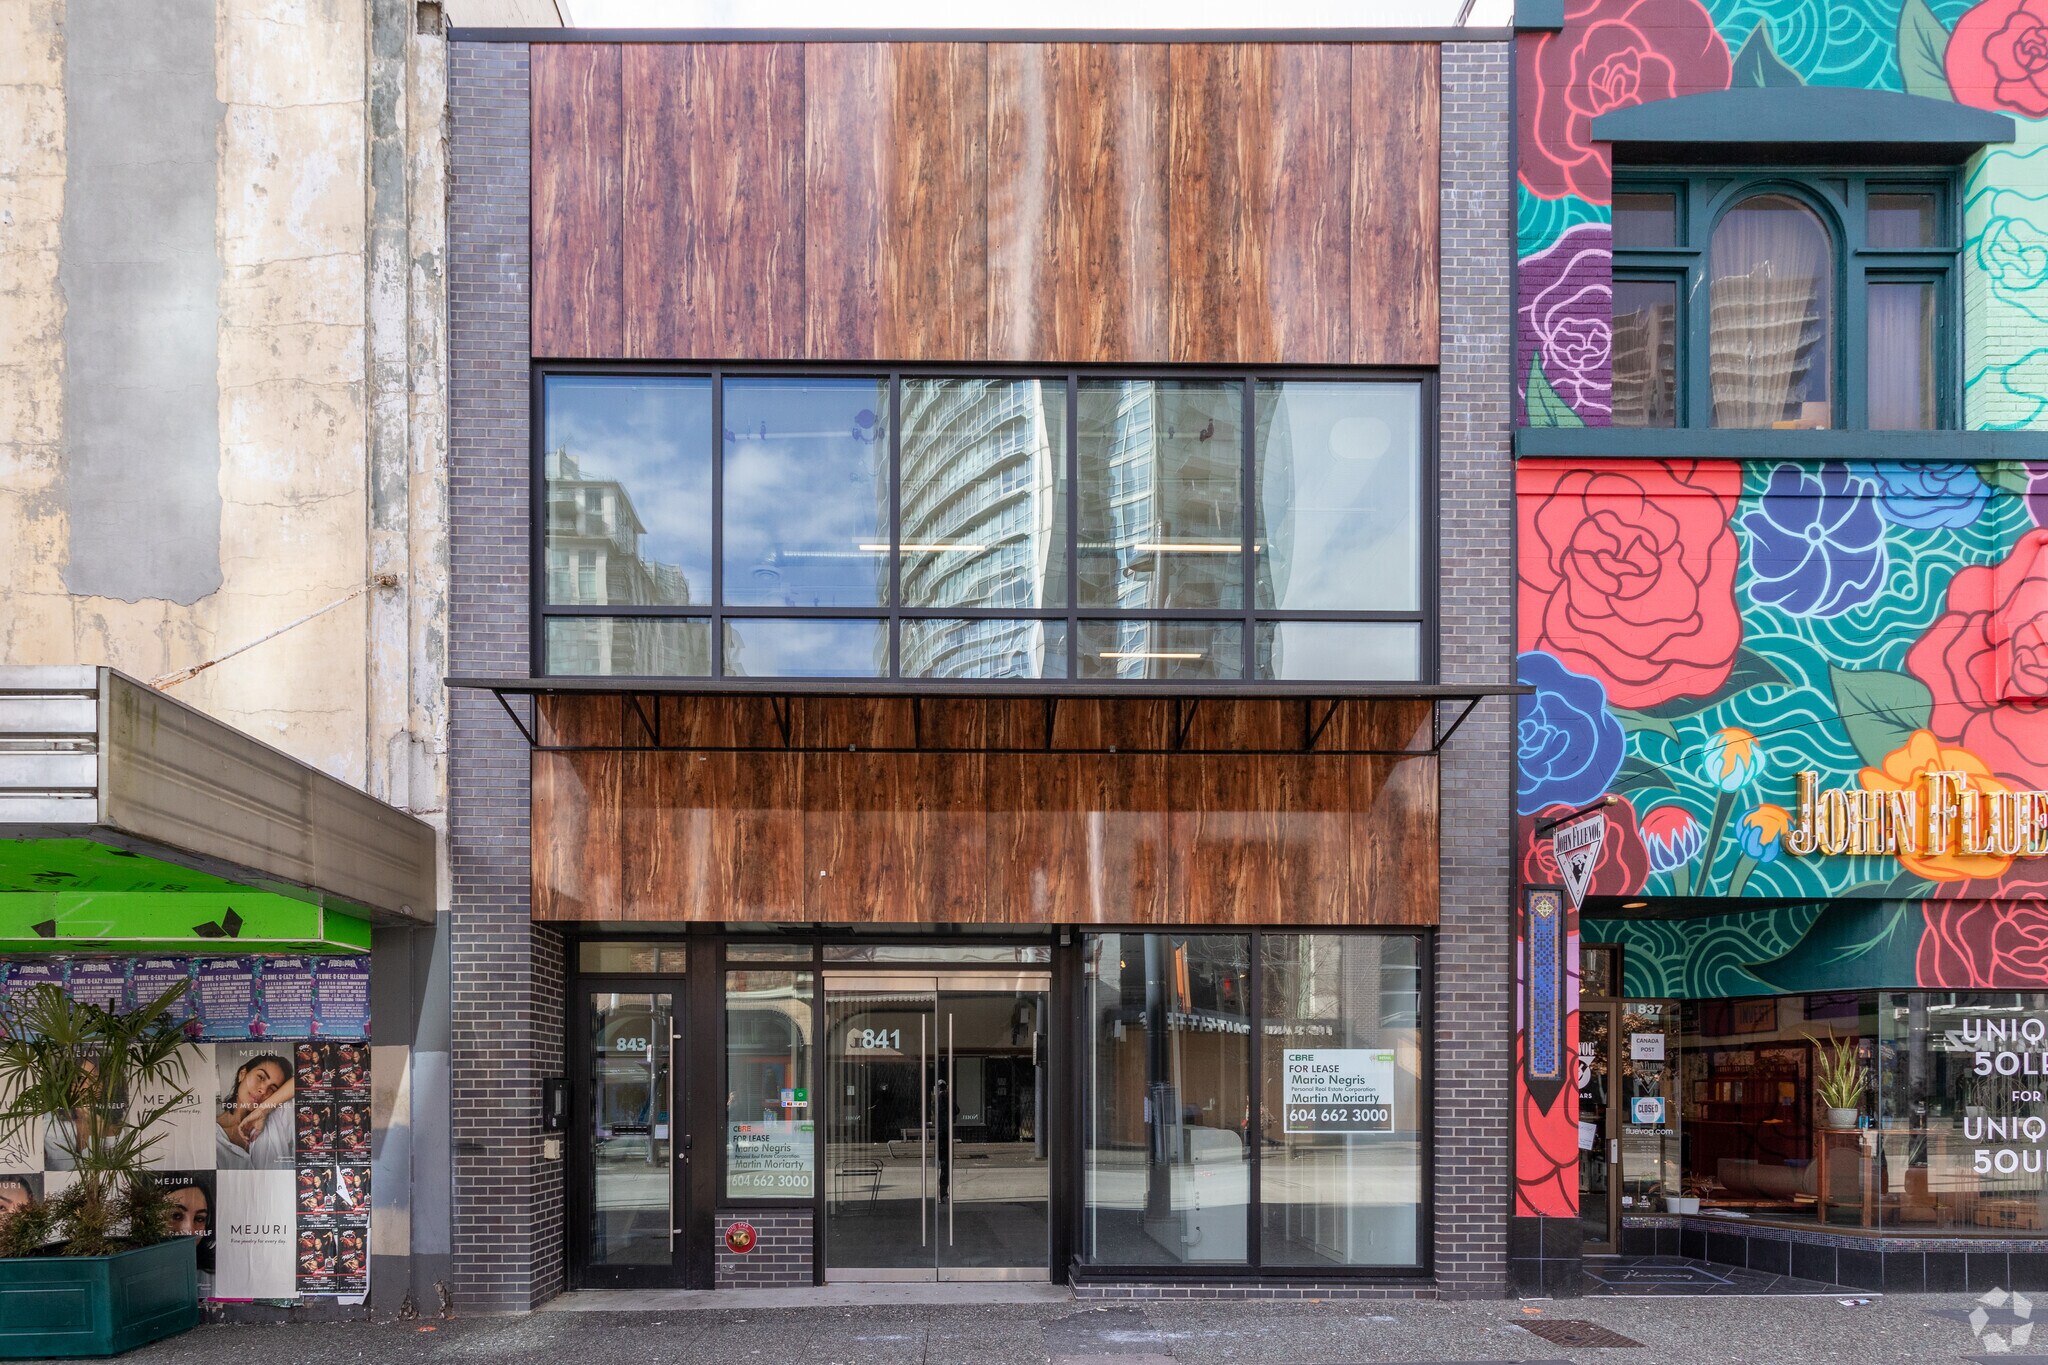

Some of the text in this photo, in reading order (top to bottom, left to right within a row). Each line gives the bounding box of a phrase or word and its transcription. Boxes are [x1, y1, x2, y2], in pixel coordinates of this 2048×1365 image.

[1781, 771, 1916, 857] JOHN
[1637, 1004, 1664, 1015] 837
[1962, 1018, 2046, 1046] UNIQ
[616, 1037, 647, 1052] 843
[862, 1028, 901, 1050] 841
[239, 1049, 279, 1057] MEJURI
[1288, 1054, 1315, 1062] CBRE
[1288, 1064, 1340, 1073] FOR LEASE
[1291, 1074, 1366, 1087] Mario Negris
[1291, 1092, 1380, 1105] Martin Moriarty
[2011, 1090, 2042, 1102] FOR
[1637, 1104, 1659, 1113] CLOSED
[1289, 1108, 1389, 1122] 604 662 3000
[732, 1125, 752, 1133] CBRE
[1625, 1127, 1674, 1137] fluevog.com
[1963, 1116, 2047, 1144] UNIQ
[732, 1134, 771, 1143] FOR LEASE
[734, 1142, 792, 1155] Mario Negris
[735, 1159, 805, 1171] Martin Moriarty
[0, 1182, 21, 1190] URI
[154, 1177, 194, 1186] MEJURI
[730, 1175, 810, 1188] 604 662 3000
[230, 1224, 287, 1236] MEJURI
